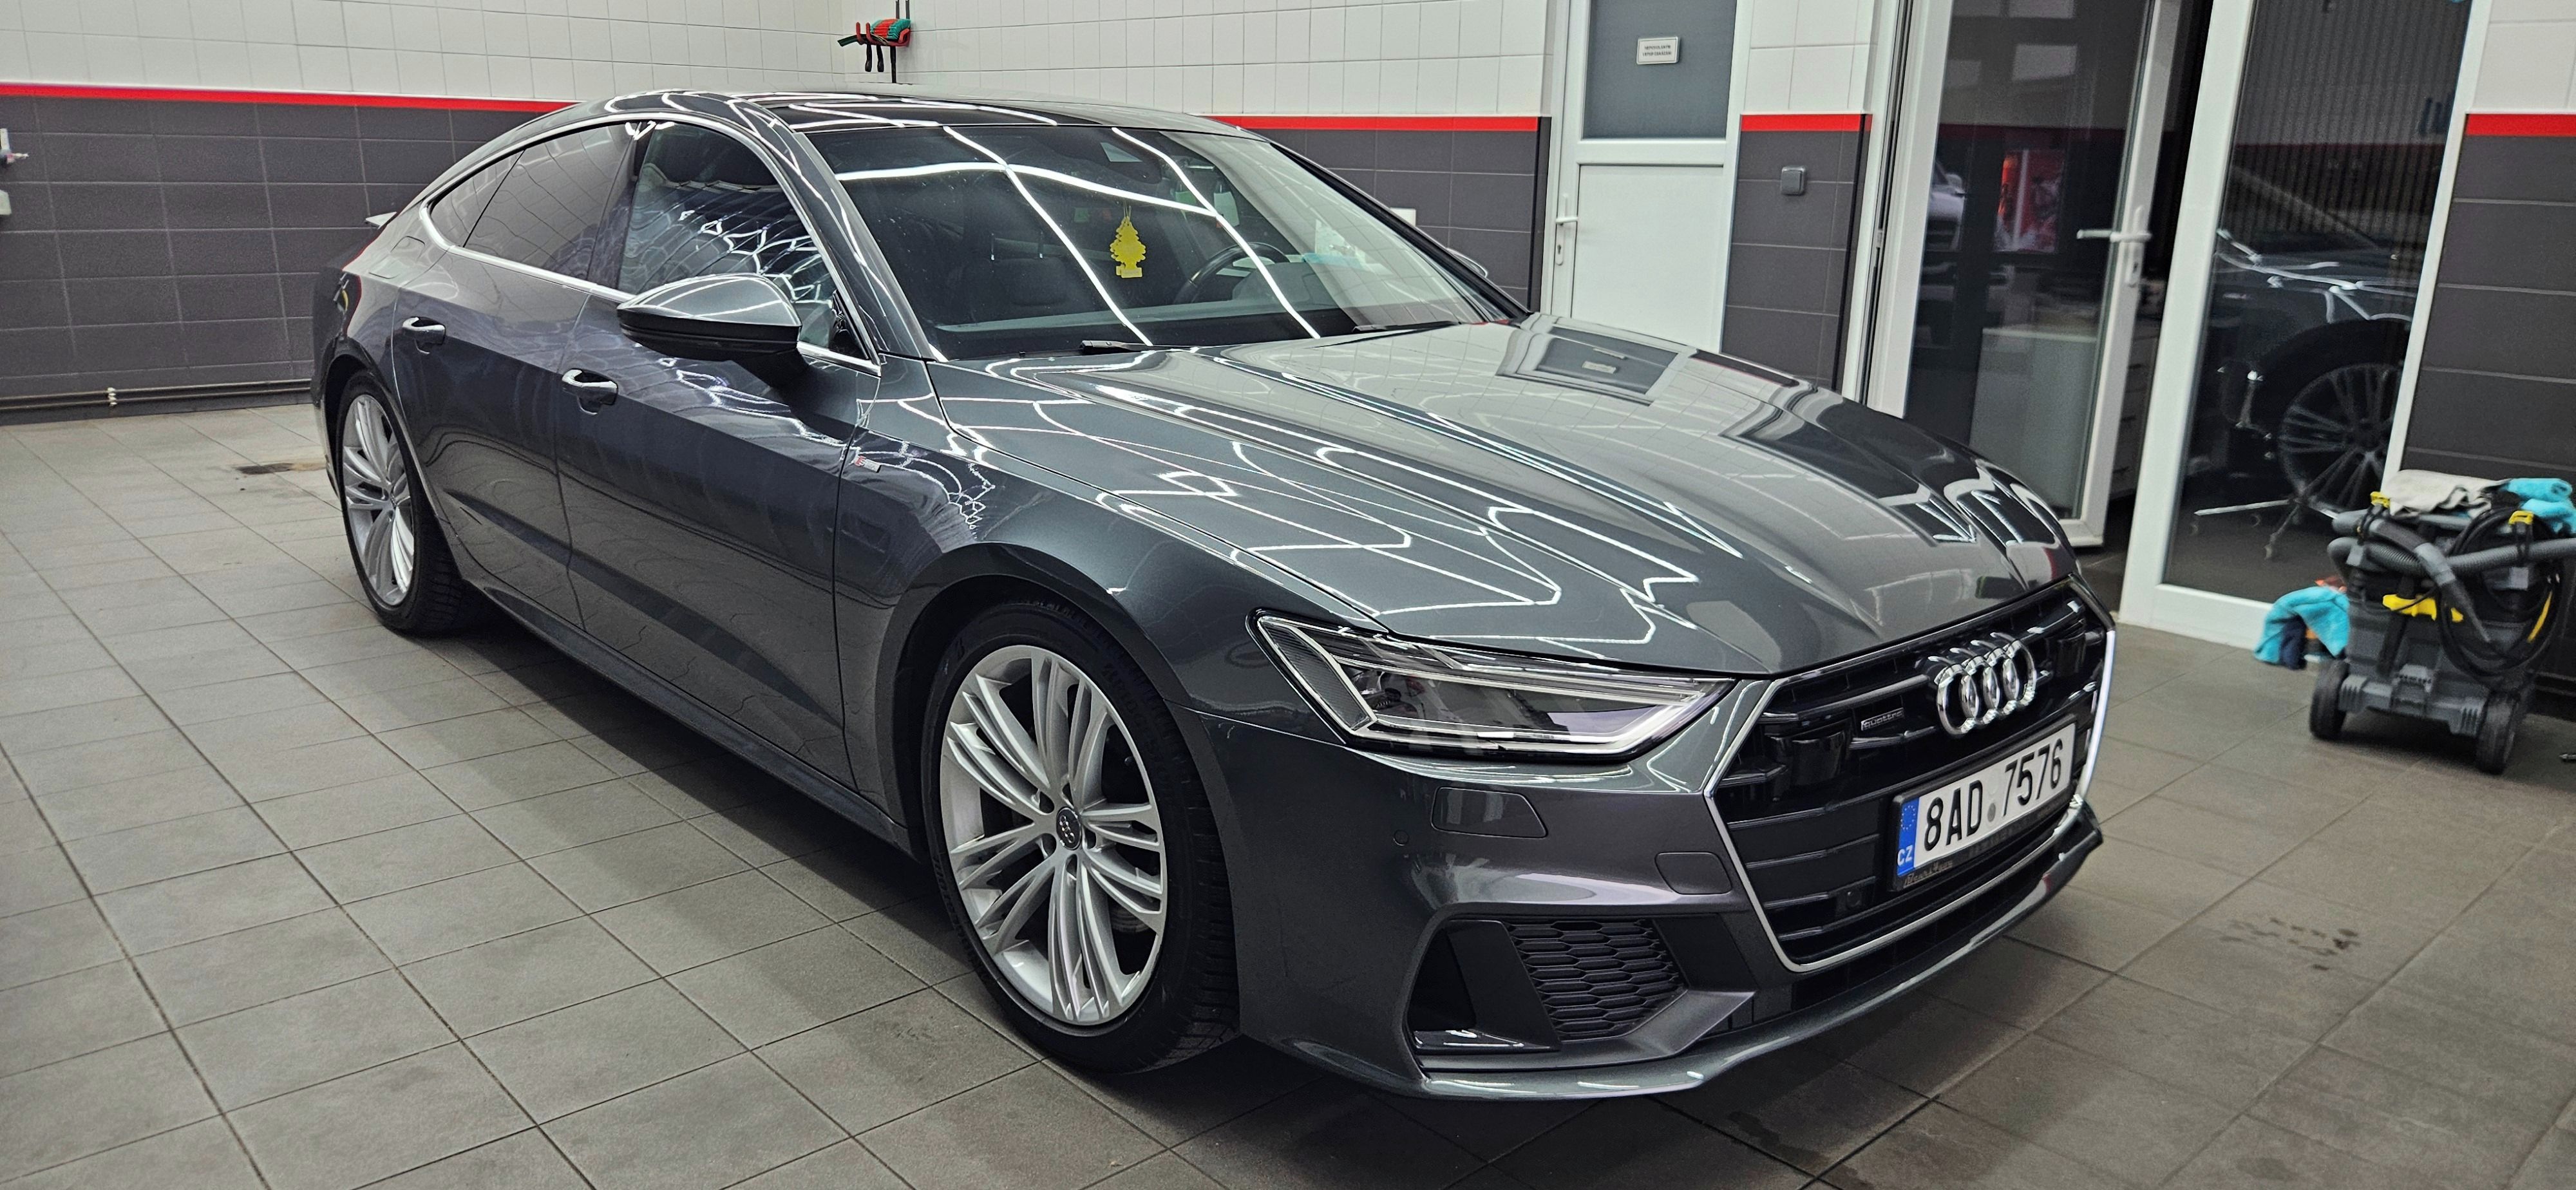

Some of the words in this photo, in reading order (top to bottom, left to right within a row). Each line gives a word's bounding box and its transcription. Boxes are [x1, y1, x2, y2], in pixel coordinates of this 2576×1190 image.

[1864, 710, 1902, 728] quattro
[1924, 779, 1983, 851] 8AD
[2002, 738, 2063, 817] 7576
[1897, 845, 1913, 865] CZ
